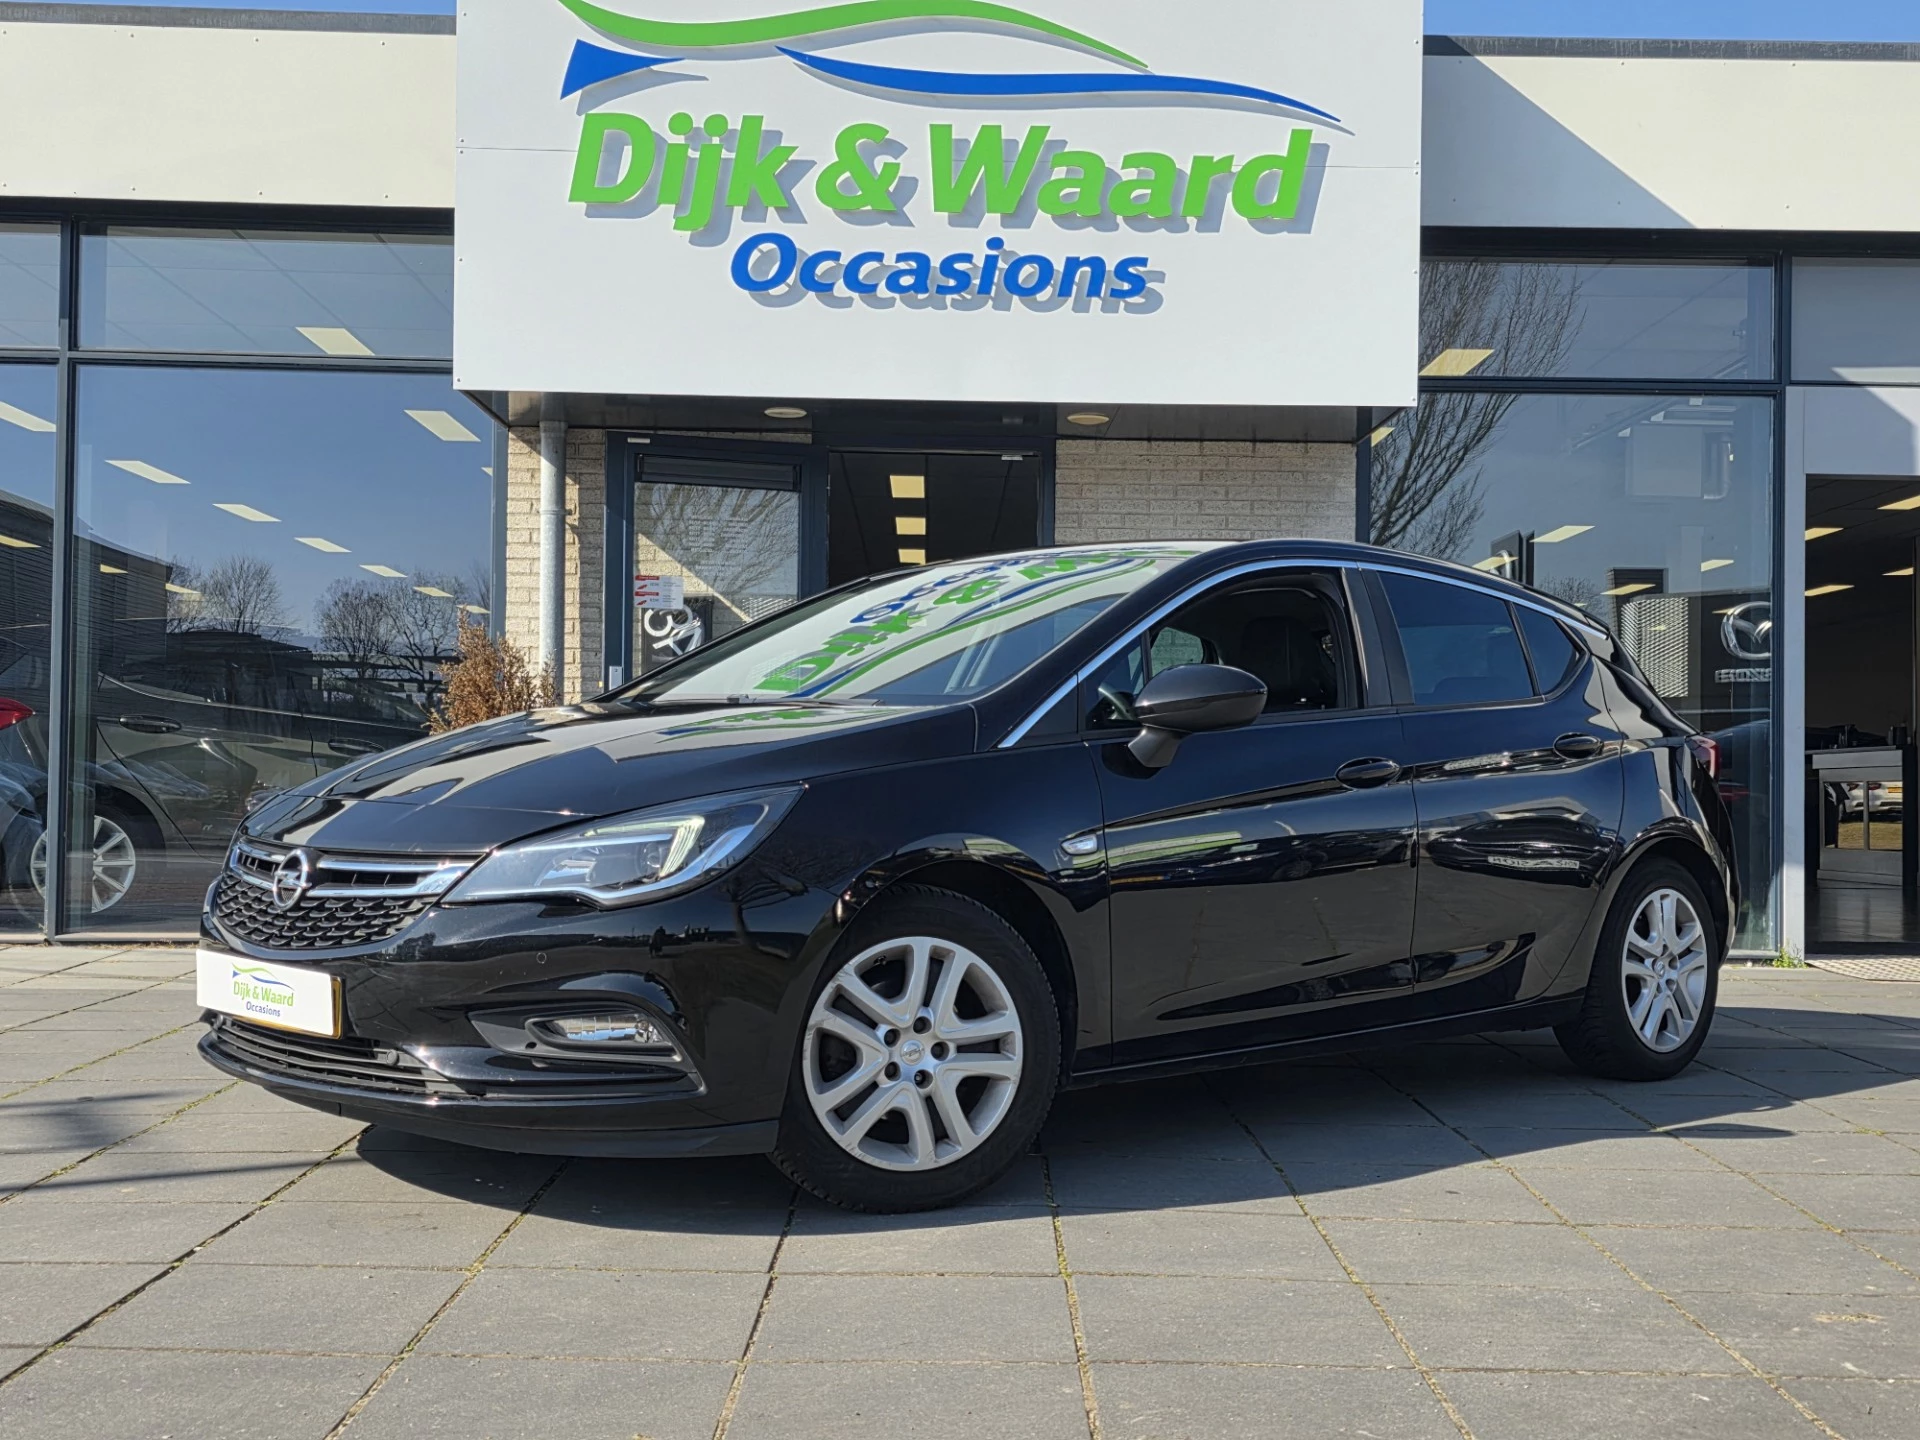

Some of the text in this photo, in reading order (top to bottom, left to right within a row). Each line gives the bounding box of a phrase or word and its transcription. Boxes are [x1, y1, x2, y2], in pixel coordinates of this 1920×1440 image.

[569, 112, 1313, 231] Dijk & Waard
[731, 233, 1149, 299] Occasions
[233, 981, 293, 1006] Dijk & Waard
[246, 1001, 280, 1016] Occasions
